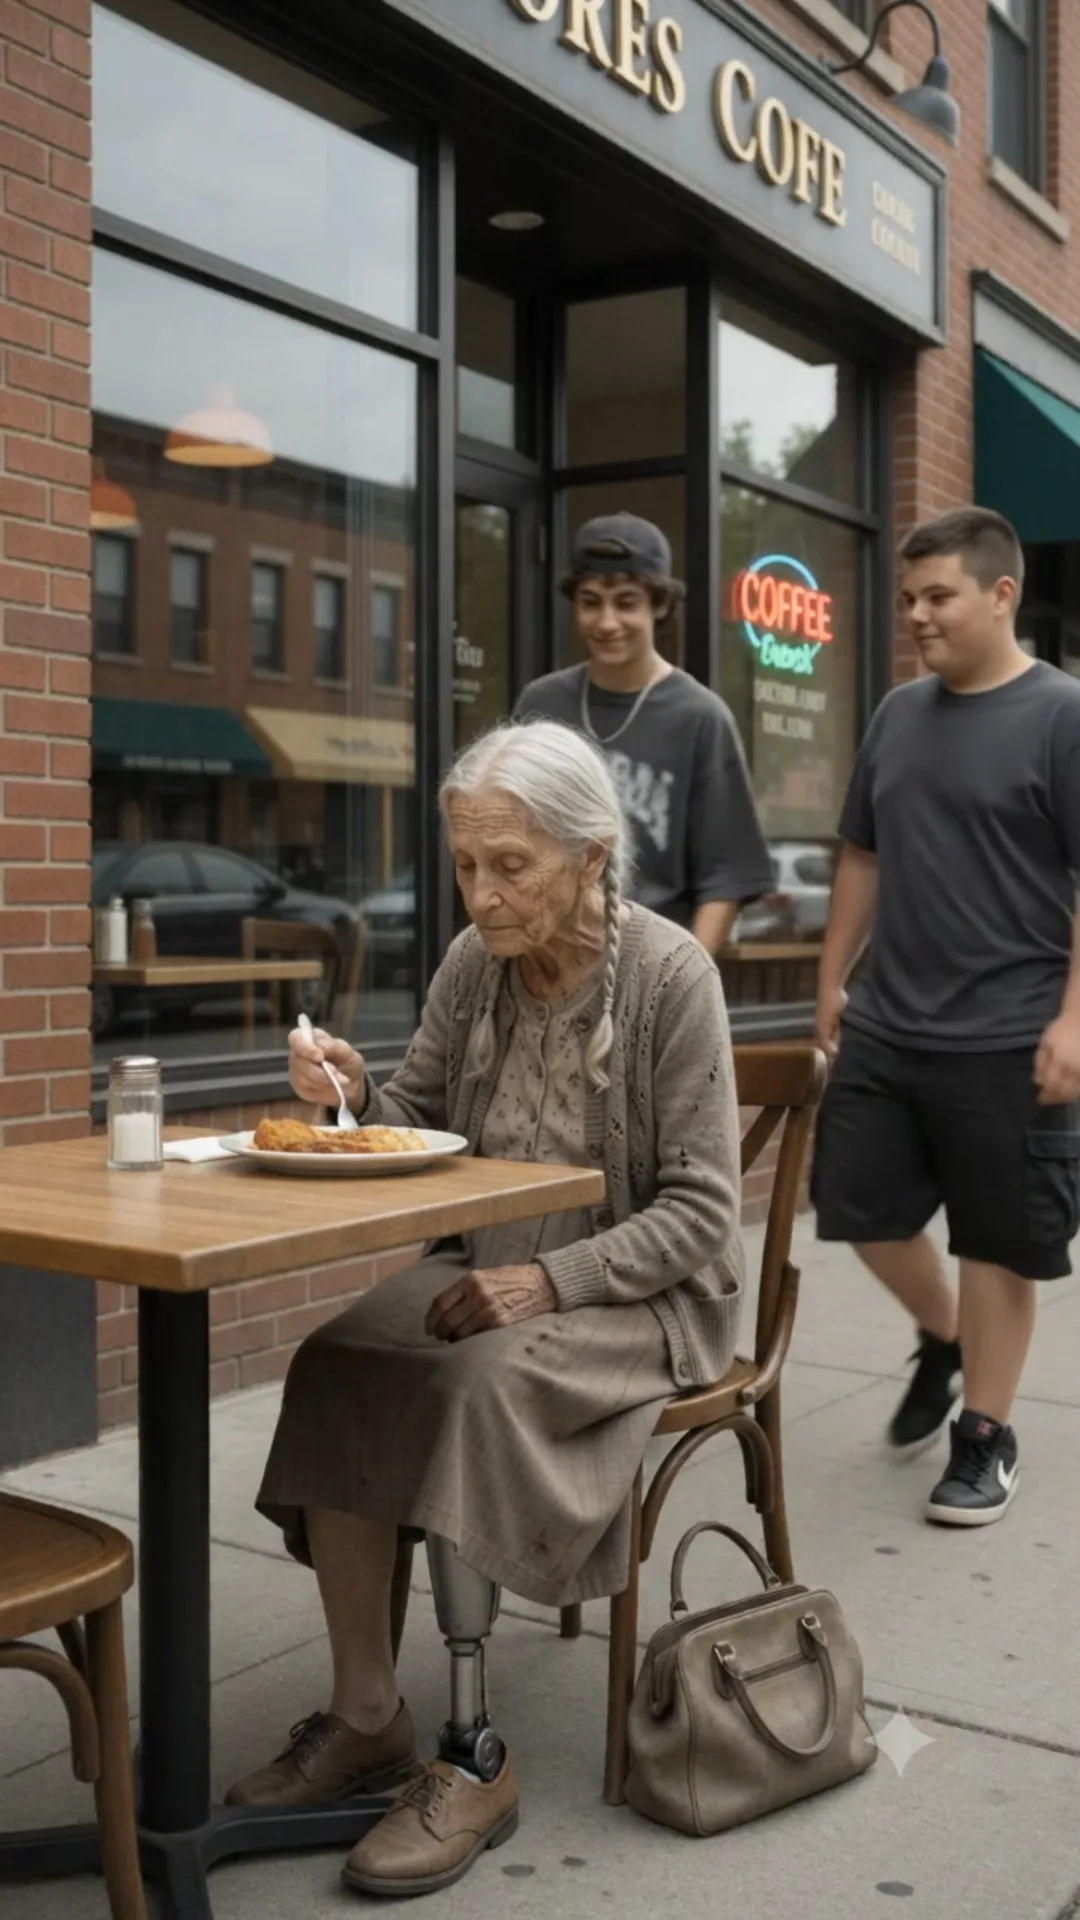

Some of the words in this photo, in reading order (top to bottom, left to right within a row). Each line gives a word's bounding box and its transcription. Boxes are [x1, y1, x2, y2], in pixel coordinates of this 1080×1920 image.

[510, 0, 686, 113] RES
[715, 59, 847, 227] COFE
[740, 572, 834, 642] COFFEE
